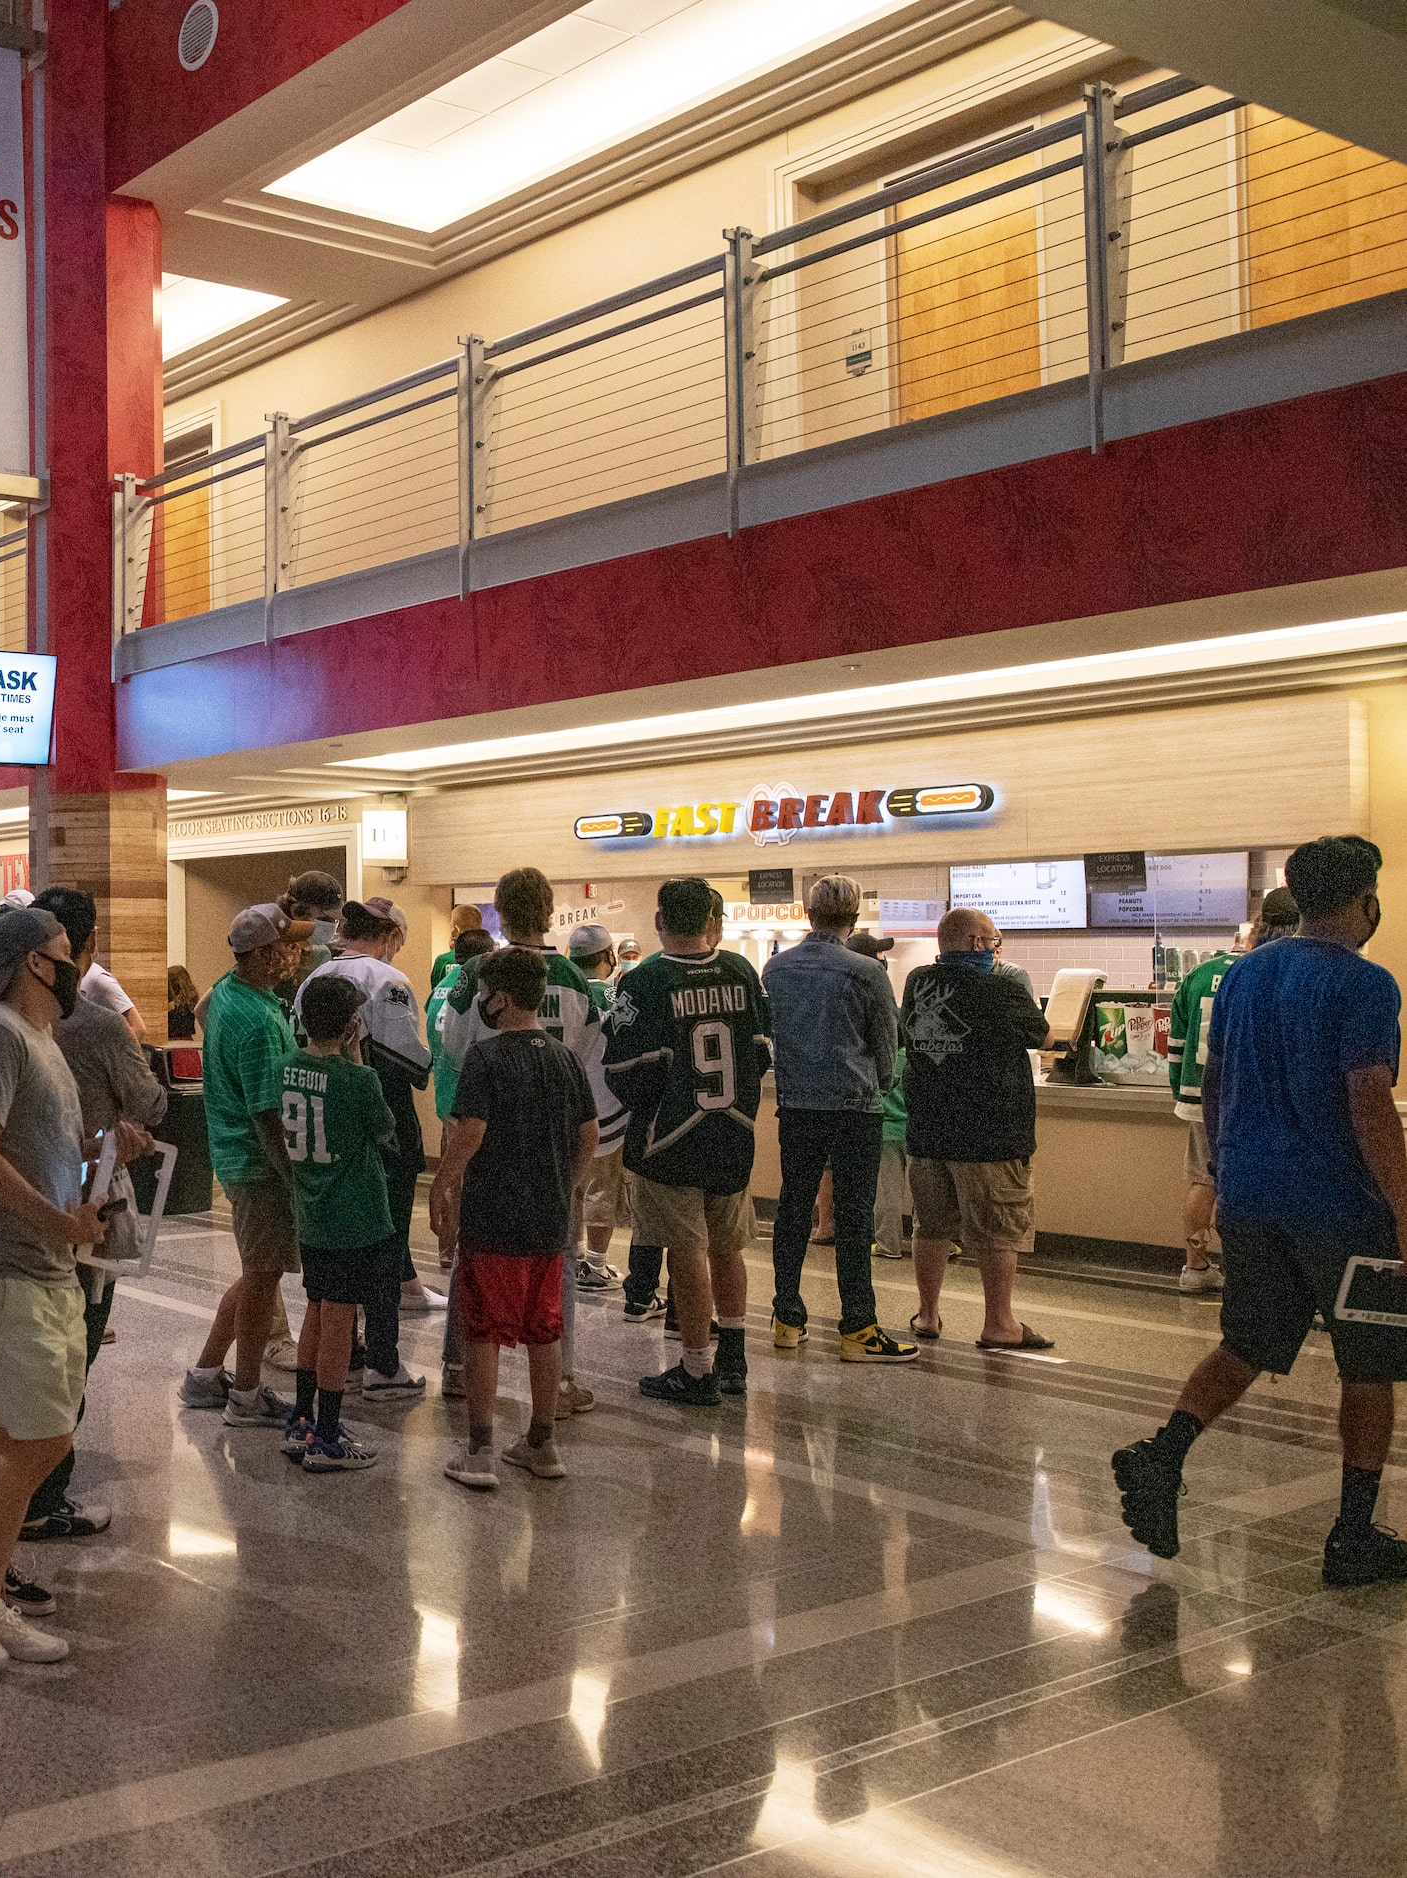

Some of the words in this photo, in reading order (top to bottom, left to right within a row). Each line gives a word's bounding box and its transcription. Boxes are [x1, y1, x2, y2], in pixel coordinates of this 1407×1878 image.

[1, 693, 32, 705] TIMES
[10, 713, 35, 724] must
[2, 725, 25, 735] seat
[167, 821, 203, 838] FLOOR
[204, 815, 253, 834] SEATING
[255, 809, 314, 830] SECTIONS
[317, 805, 348, 824] 16-18
[652, 801, 743, 839] FAST
[750, 789, 887, 832] BREAK
[1096, 864, 1134, 873] LOCATION
[1099, 854, 1130, 863] EXPRESS
[559, 906, 598, 927] BREAK
[733, 903, 808, 921] POPCO
[669, 984, 746, 1018] MODANO
[691, 1019, 737, 1111] 9
[282, 1066, 329, 1094] SEGUIN
[281, 1090, 332, 1164] 91
